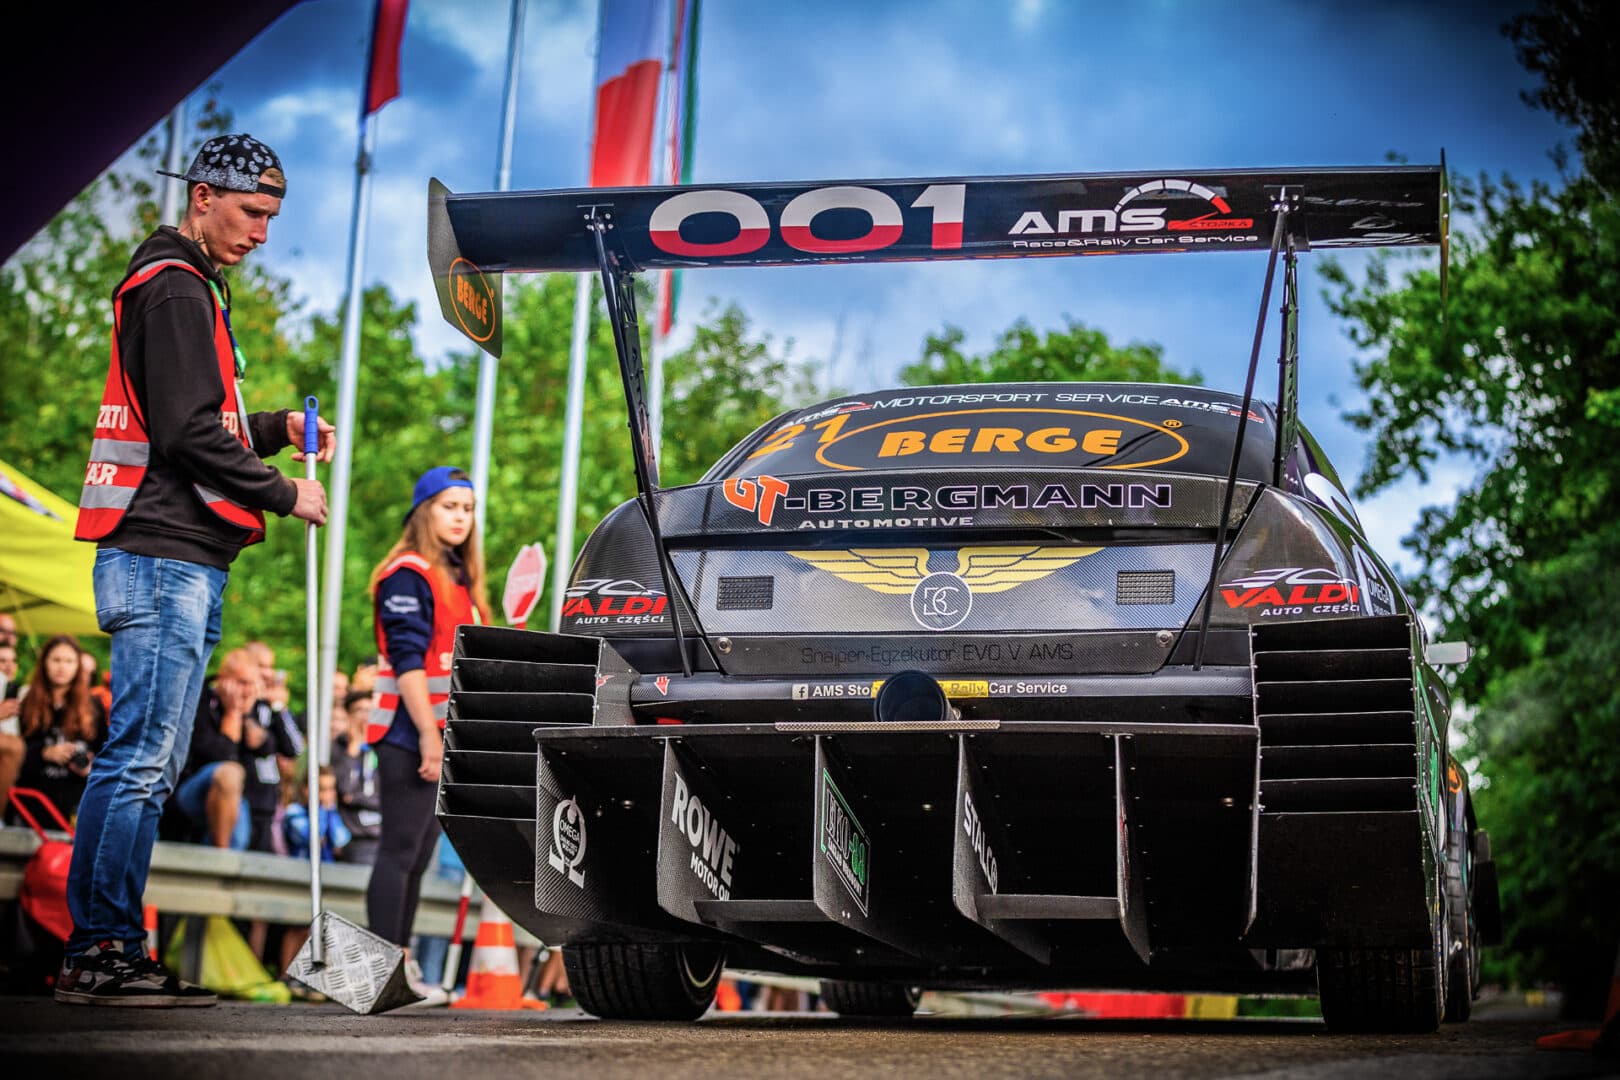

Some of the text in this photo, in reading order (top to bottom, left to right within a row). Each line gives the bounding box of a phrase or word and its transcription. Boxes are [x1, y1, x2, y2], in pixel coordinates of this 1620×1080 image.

[649, 184, 967, 257] 001
[1008, 207, 1168, 235] AMS
[1135, 236, 1175, 245] Car
[1178, 235, 1259, 244] Service
[456, 273, 488, 326] BERGE
[873, 393, 1161, 409] MOTORSPORT SERVICE
[747, 414, 851, 460] 21
[878, 427, 1122, 458] BERGE
[799, 517, 974, 529] AUTOMOTIVE
[575, 616, 609, 625] AUTO
[1260, 606, 1303, 617] AUTO
[963, 644, 1000, 661] EVO
[1006, 644, 1022, 661] V
[1029, 643, 1074, 660] AMS
[812, 685, 844, 697] AMS
[988, 682, 1012, 694] Car
[1013, 682, 1068, 694] Service
[671, 771, 736, 888] ROWE
[690, 851, 718, 897] MOTOR
